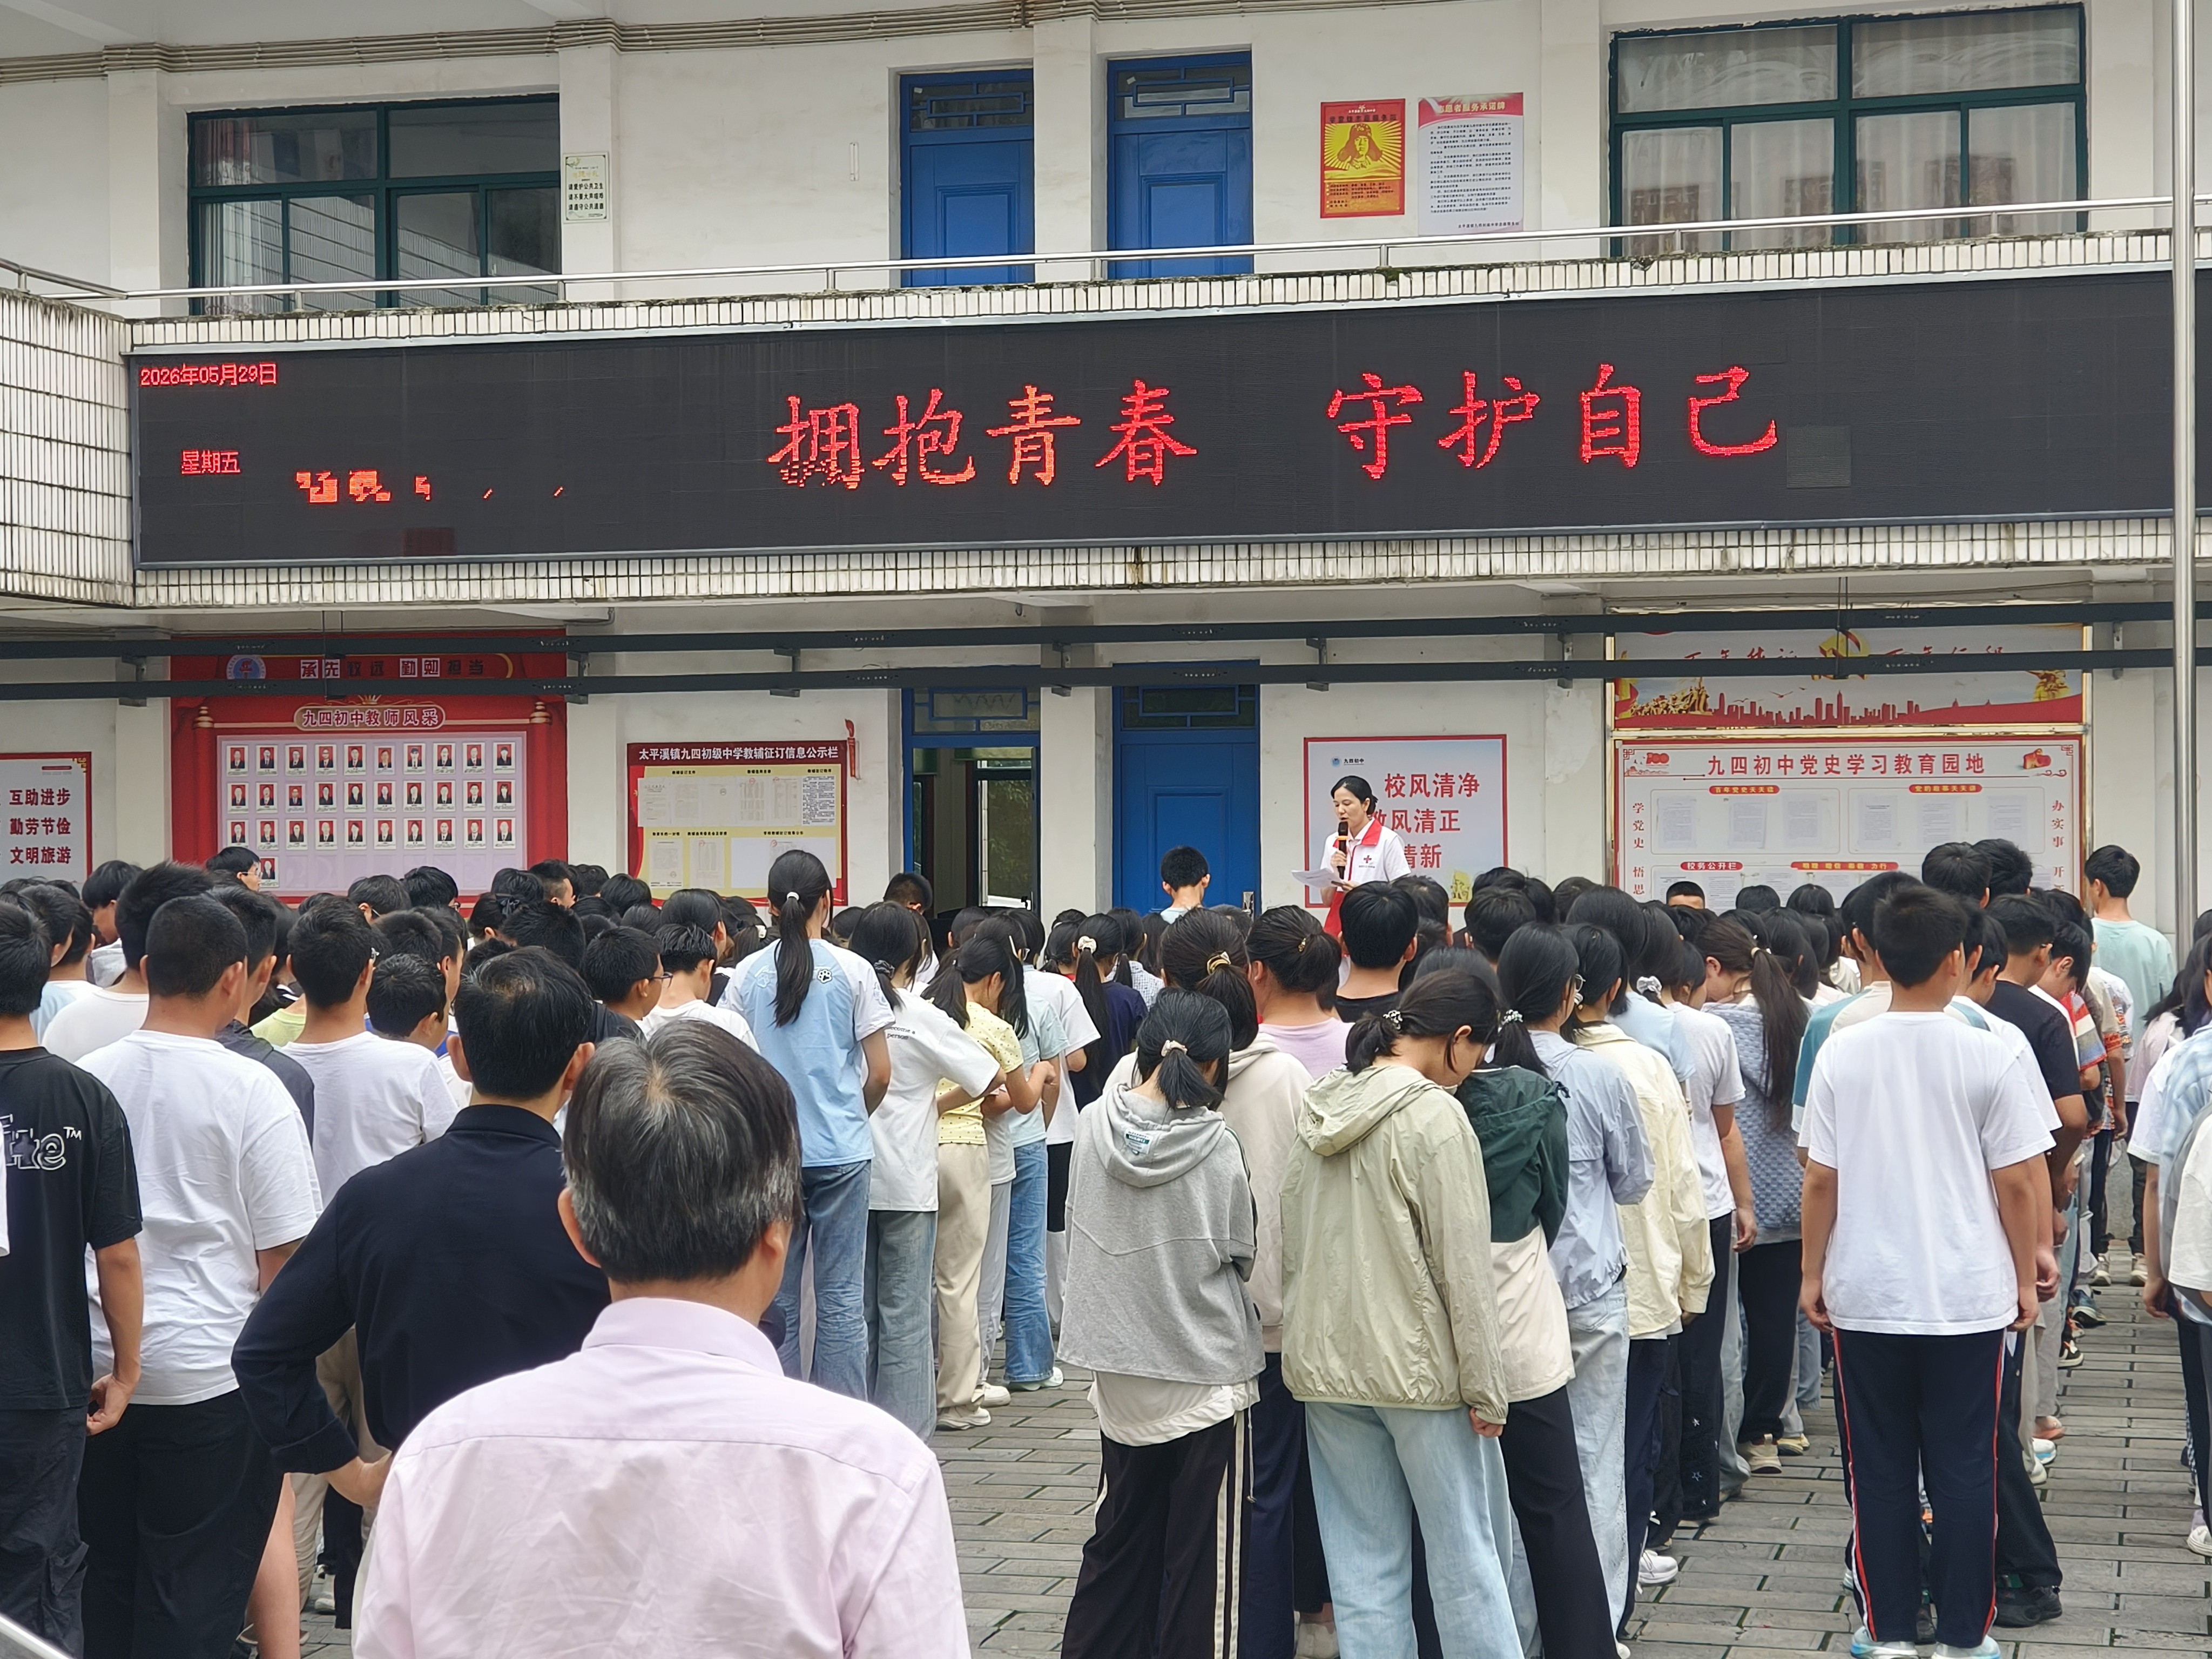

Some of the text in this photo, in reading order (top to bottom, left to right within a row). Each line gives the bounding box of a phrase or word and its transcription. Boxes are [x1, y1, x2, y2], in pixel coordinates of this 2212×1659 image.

[140, 362, 277, 387] 2026年05月29日
[767, 363, 1778, 490] 拥抱青春 守护自己
[181, 449, 241, 475] 星期五
[302, 709, 439, 727] 九四初中教师风采
[639, 746, 839, 760] 太平溪镇九四初级中学教辅征订信息公示栏
[1708, 753, 1985, 776] 九四初中党史学习教育园地
[9, 788, 71, 806] 互助进步
[1384, 773, 1480, 798] 校风清净
[10, 817, 71, 835] 勤劳节俭
[1633, 802, 1644, 849] 学党史
[2052, 800, 2065, 848] 办实事
[10, 846, 71, 865] 文明旅游
